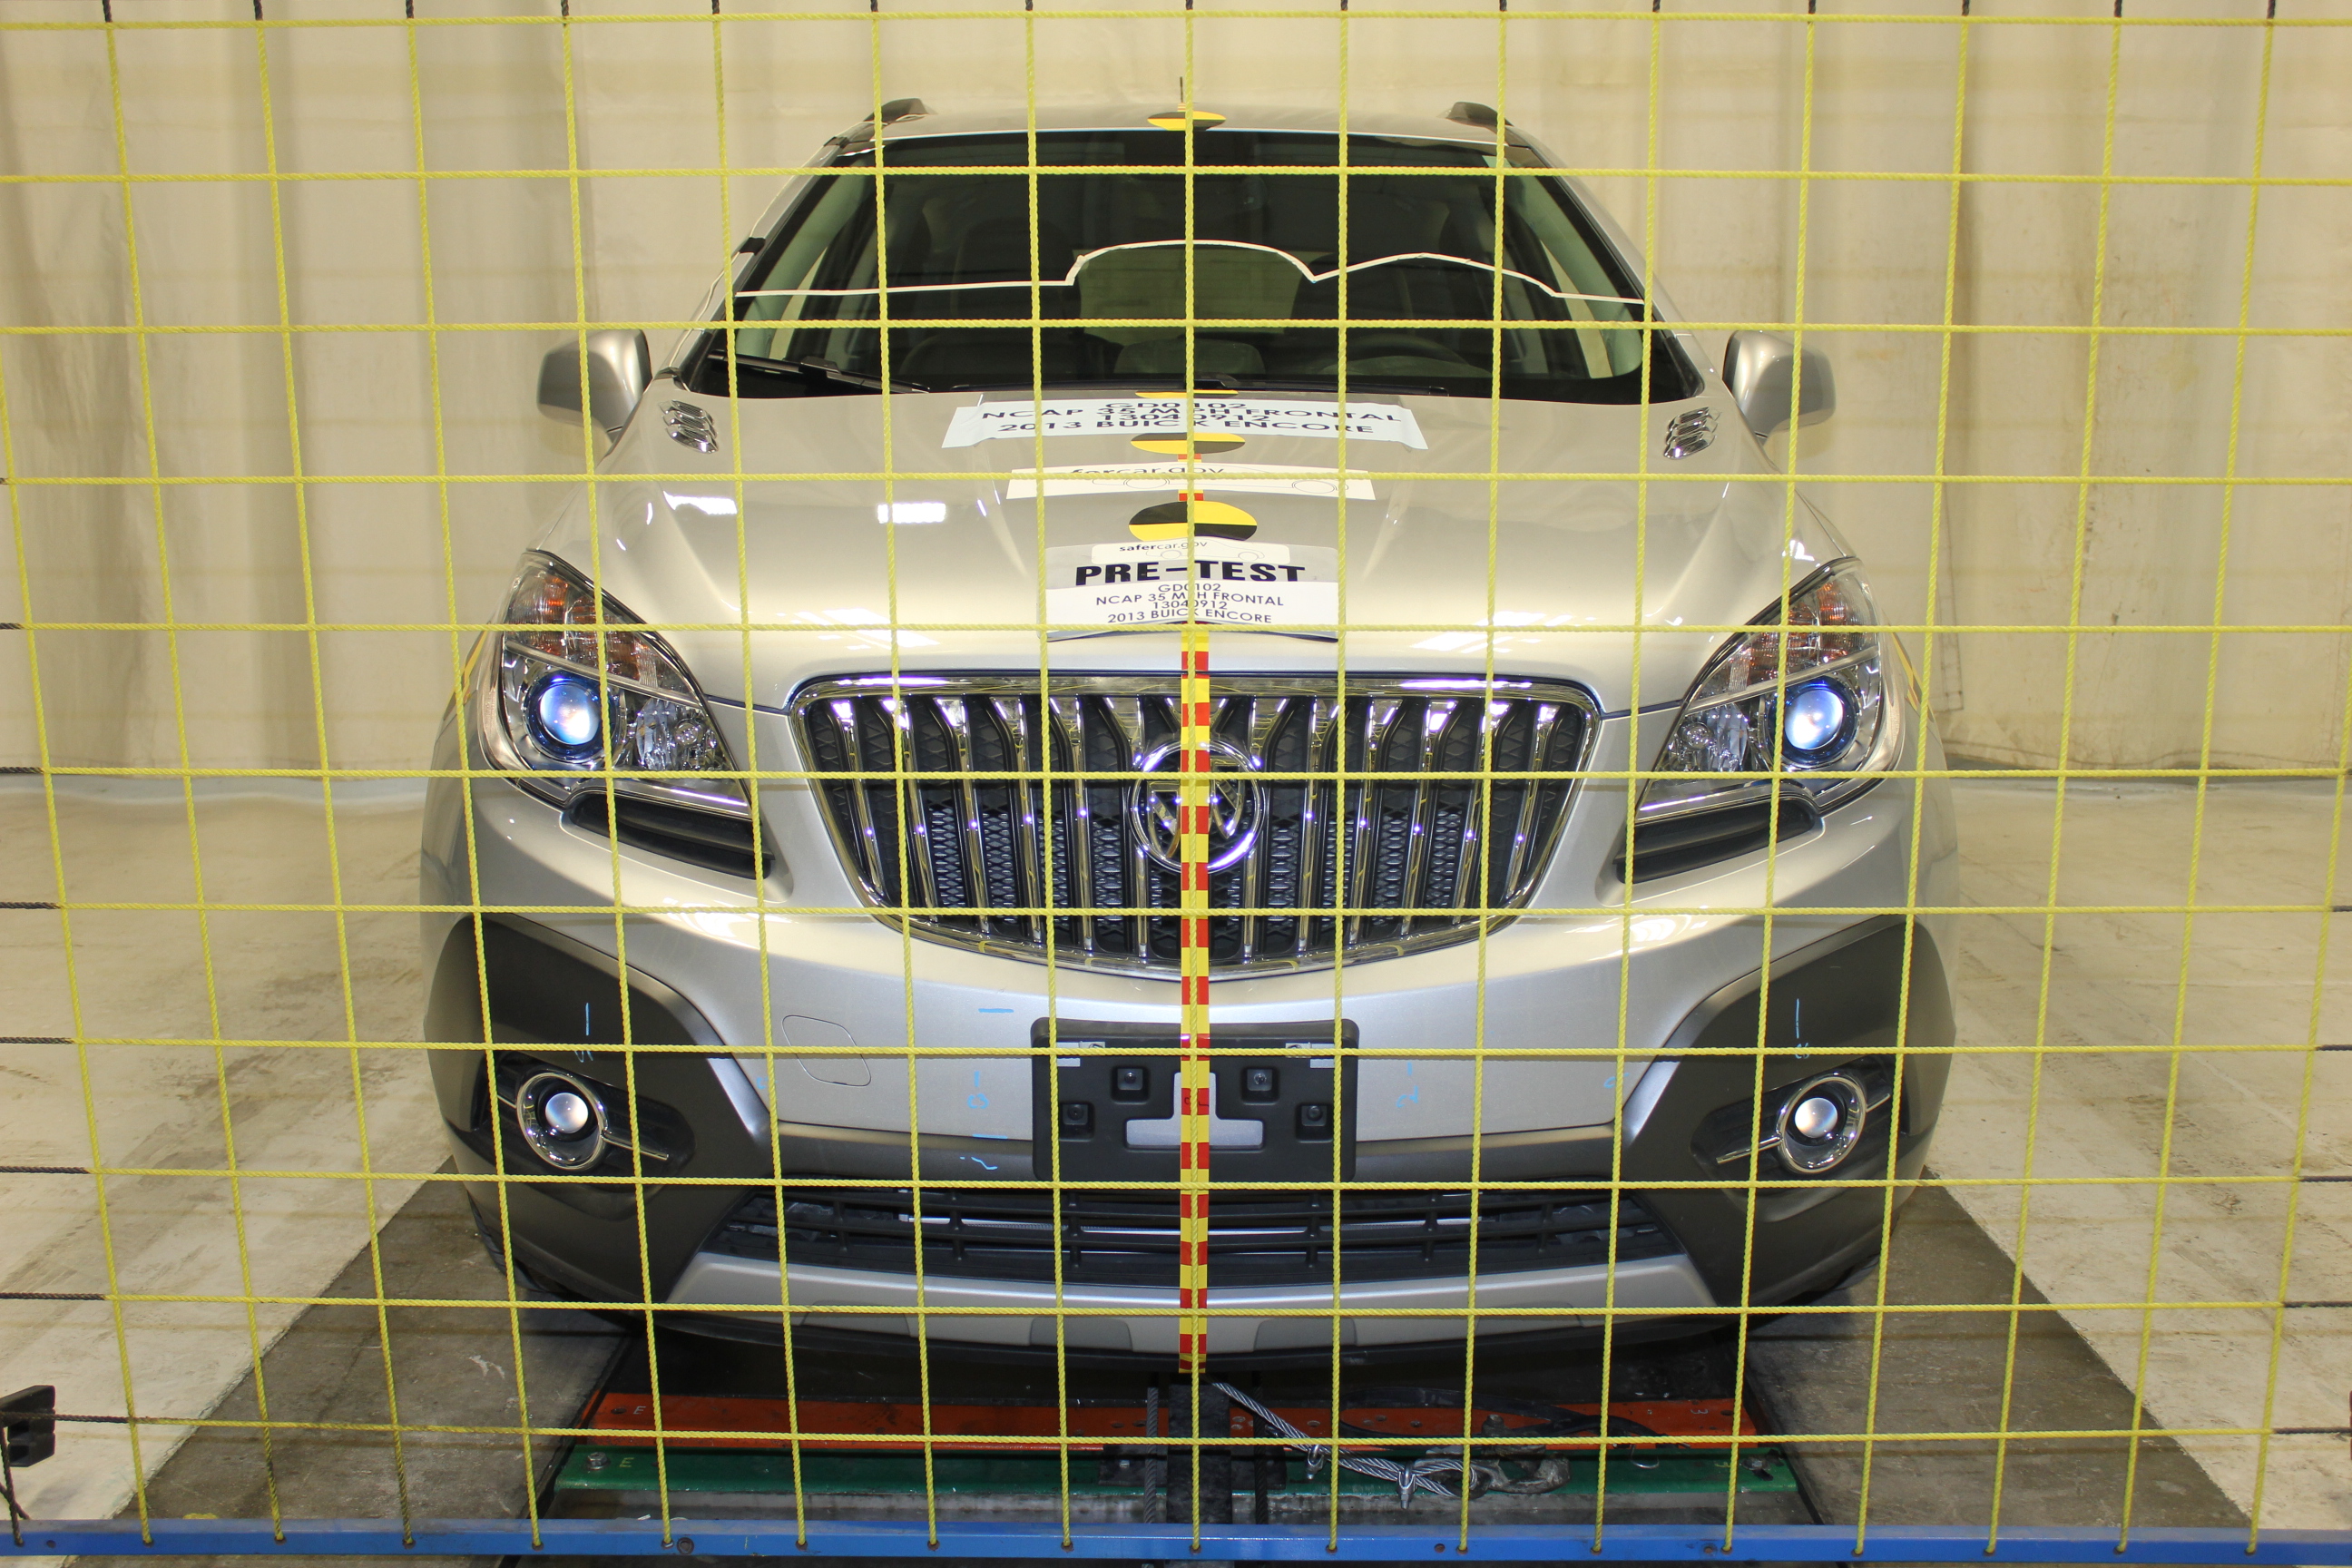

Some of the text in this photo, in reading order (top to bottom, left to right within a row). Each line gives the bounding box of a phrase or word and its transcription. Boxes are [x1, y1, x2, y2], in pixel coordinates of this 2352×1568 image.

[982, 408, 1083, 419] NCAP
[1246, 408, 1402, 422] FRONTAL
[997, 421, 1083, 431] 2013
[1225, 420, 1374, 433] ENCORE
[1075, 560, 1306, 586] PRE-TEST
[1096, 592, 1284, 606] NCAP 35 MH FRONTAL
[1107, 611, 1145, 623] 2013
[1205, 609, 1272, 623] ENCORE
